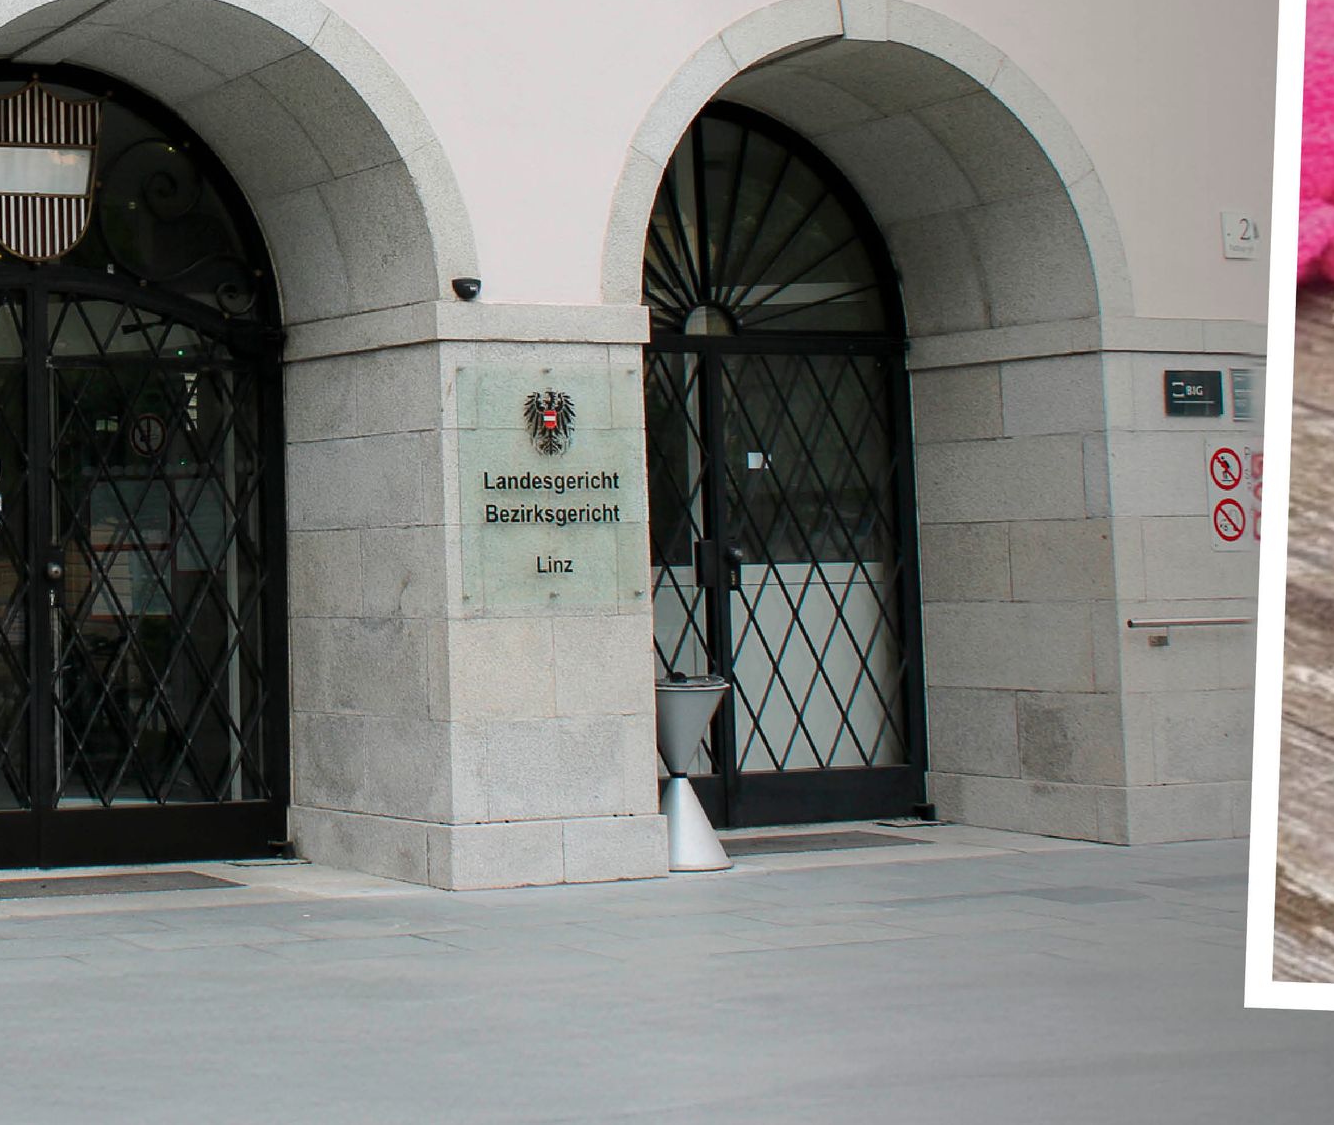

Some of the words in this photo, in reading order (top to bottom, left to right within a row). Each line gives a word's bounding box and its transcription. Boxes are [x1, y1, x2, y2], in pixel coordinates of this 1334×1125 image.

[1185, 385, 1203, 396] BIG
[483, 471, 620, 494] Landesgericht
[485, 503, 620, 526] Bezirksgericht
[536, 555, 574, 574] Linz
